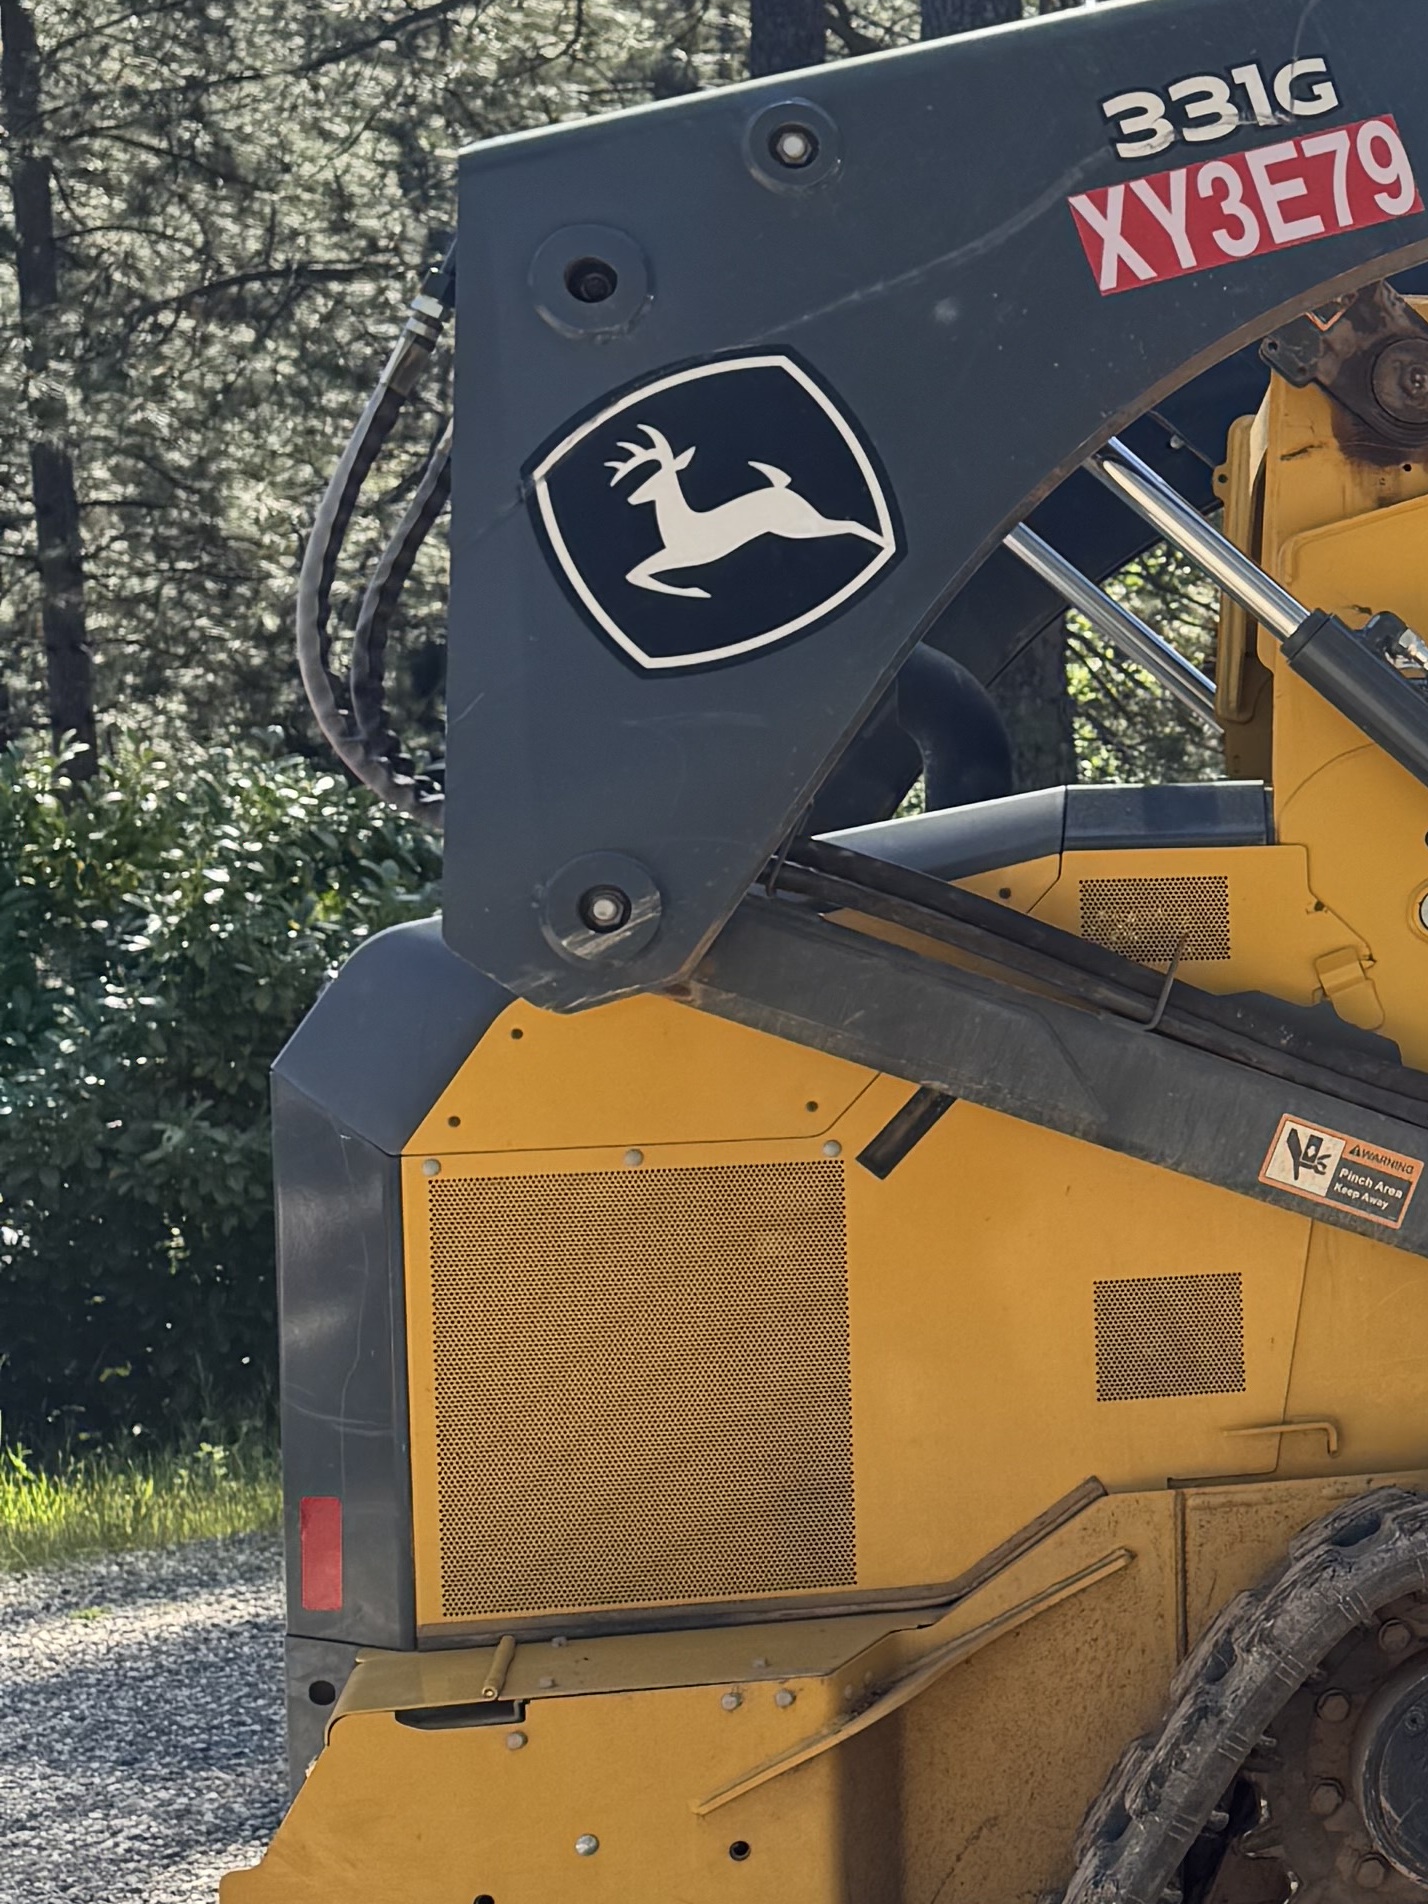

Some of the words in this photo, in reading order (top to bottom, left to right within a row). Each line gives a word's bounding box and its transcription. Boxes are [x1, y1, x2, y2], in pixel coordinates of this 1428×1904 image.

[1102, 57, 1339, 159] 331G
[1068, 120, 1416, 291] XY3E79
[1361, 1149, 1414, 1174] WARNING
[1333, 1182, 1360, 1199] Keep
[1361, 1192, 1389, 1210] Away
[1339, 1168, 1373, 1189] Pinch
[1374, 1181, 1403, 1199] Area
